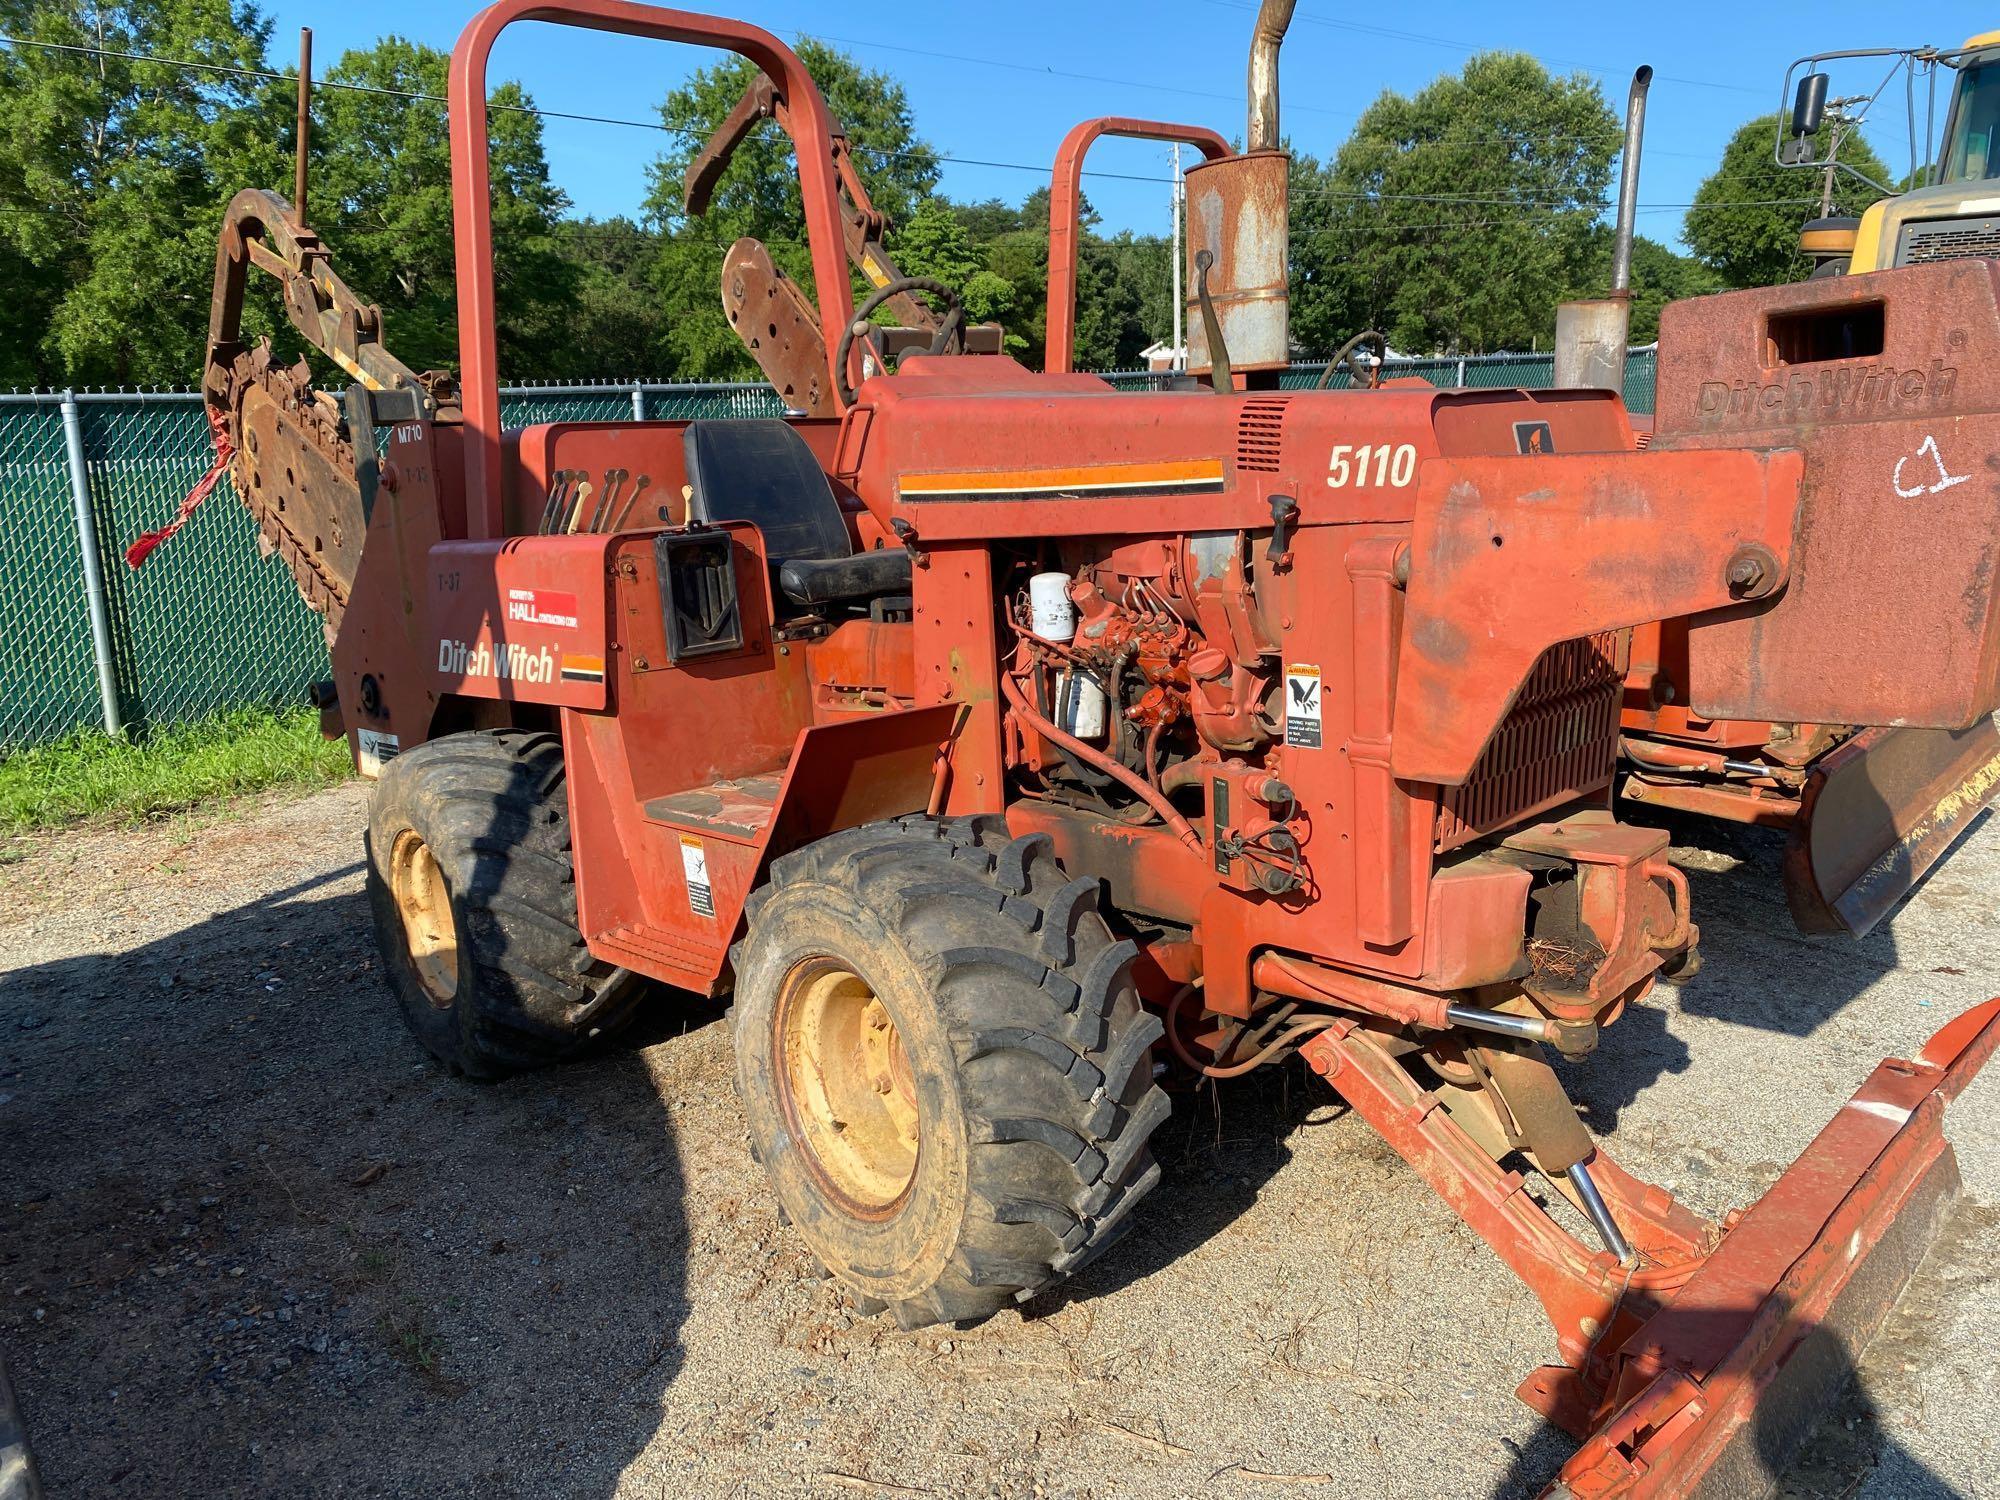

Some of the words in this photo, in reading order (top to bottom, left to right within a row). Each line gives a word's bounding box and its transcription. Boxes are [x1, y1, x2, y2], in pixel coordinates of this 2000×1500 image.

[1694, 372, 1812, 416] Ditch
[1818, 358, 1959, 409] Witch
[397, 424, 422, 444] M710
[1327, 443, 1417, 488] 5110
[437, 570, 460, 592] T-37
[509, 601, 539, 623] HALL
[438, 638, 490, 677] Ditch
[493, 641, 553, 684] Witch
[1294, 667, 1320, 676] WARNING
